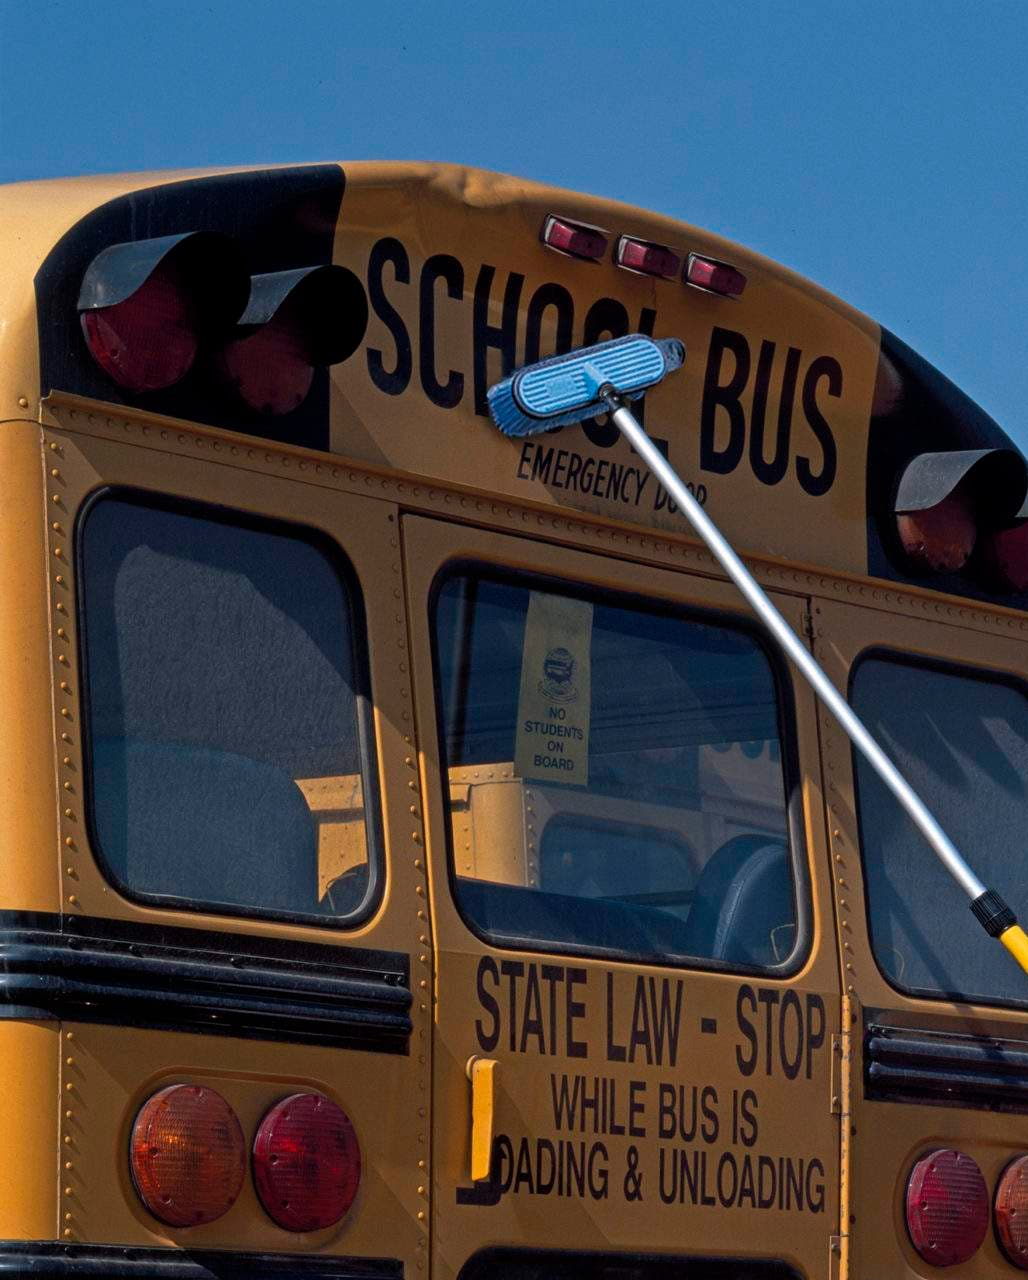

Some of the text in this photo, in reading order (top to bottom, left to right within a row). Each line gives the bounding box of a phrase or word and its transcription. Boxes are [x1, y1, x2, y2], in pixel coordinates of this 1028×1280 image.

[701, 326, 843, 497] BUS
[516, 441, 650, 506] EMERGENCY
[524, 720, 584, 740] STUDENTS
[549, 707, 566, 721] NO
[533, 754, 575, 771] BOARD
[547, 740, 564, 754] ON
[475, 954, 588, 1059] STATE
[606, 971, 684, 1067] LAW
[735, 983, 826, 1081] STOP
[550, 1073, 759, 1148] WHILE BUS IS
[490, 1133, 826, 1213] OADING & UNLOADING
